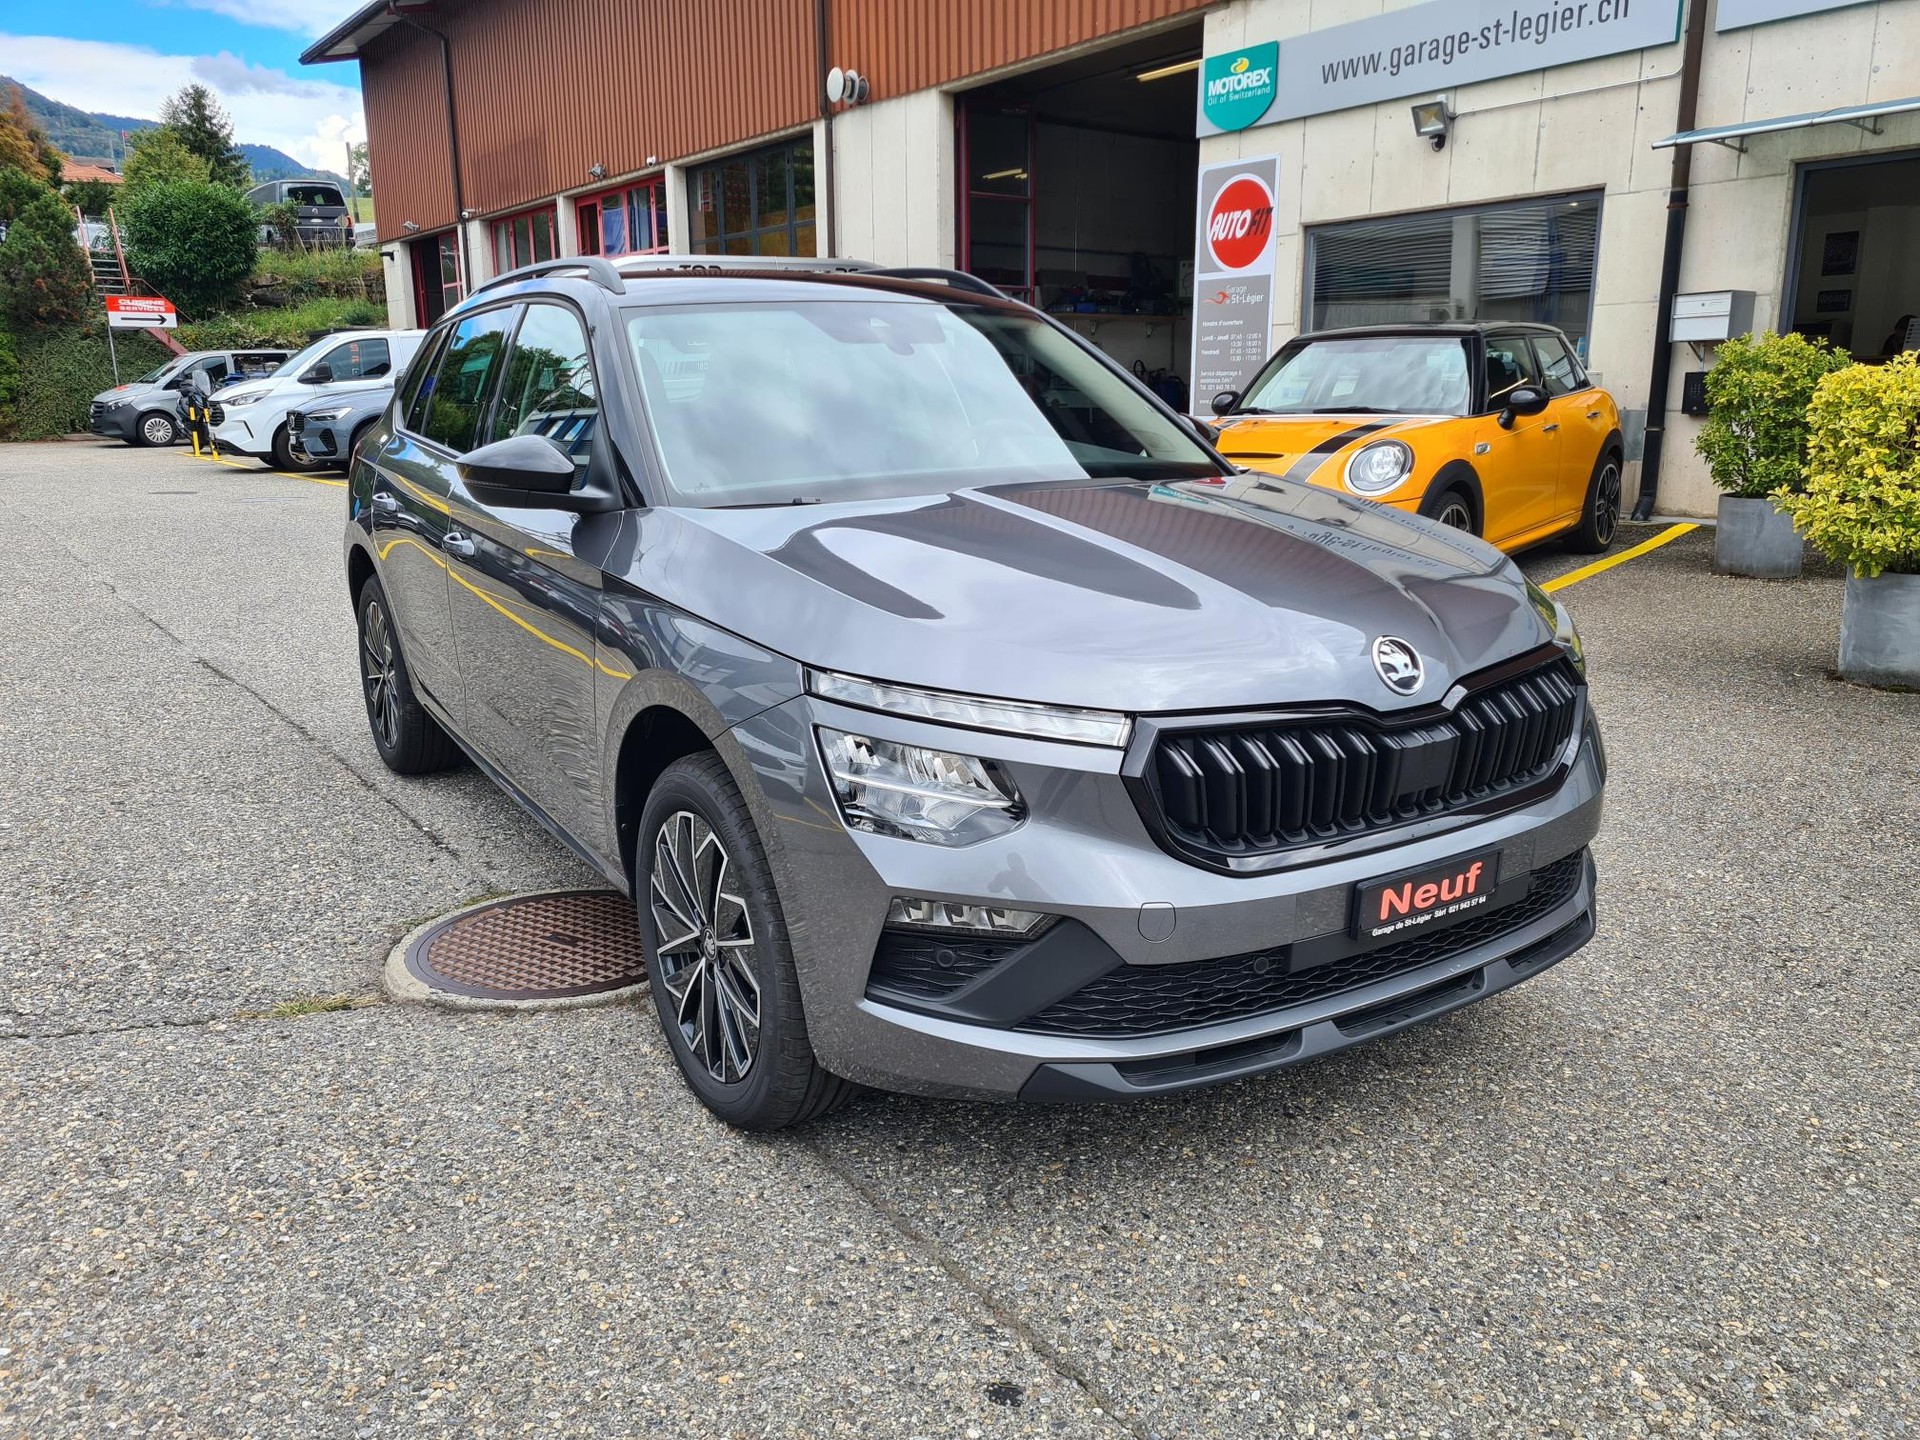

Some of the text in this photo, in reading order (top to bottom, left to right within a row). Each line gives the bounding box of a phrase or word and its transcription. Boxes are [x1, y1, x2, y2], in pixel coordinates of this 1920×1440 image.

[1208, 67, 1272, 97] MOTOREX
[1207, 85, 1271, 106] Oil of Switzerland
[1226, 285, 1248, 295] Garage
[1231, 293, 1264, 305] St-Légier
[1379, 861, 1483, 921] Neuf
[1371, 924, 1395, 937] Garage
[1395, 921, 1404, 930] de
[1404, 913, 1433, 927] St-Légier
[1448, 903, 1459, 913] 021
[1459, 900, 1470, 910] 943
[1471, 897, 1479, 906] 57
[1478, 895, 1487, 904] 64
